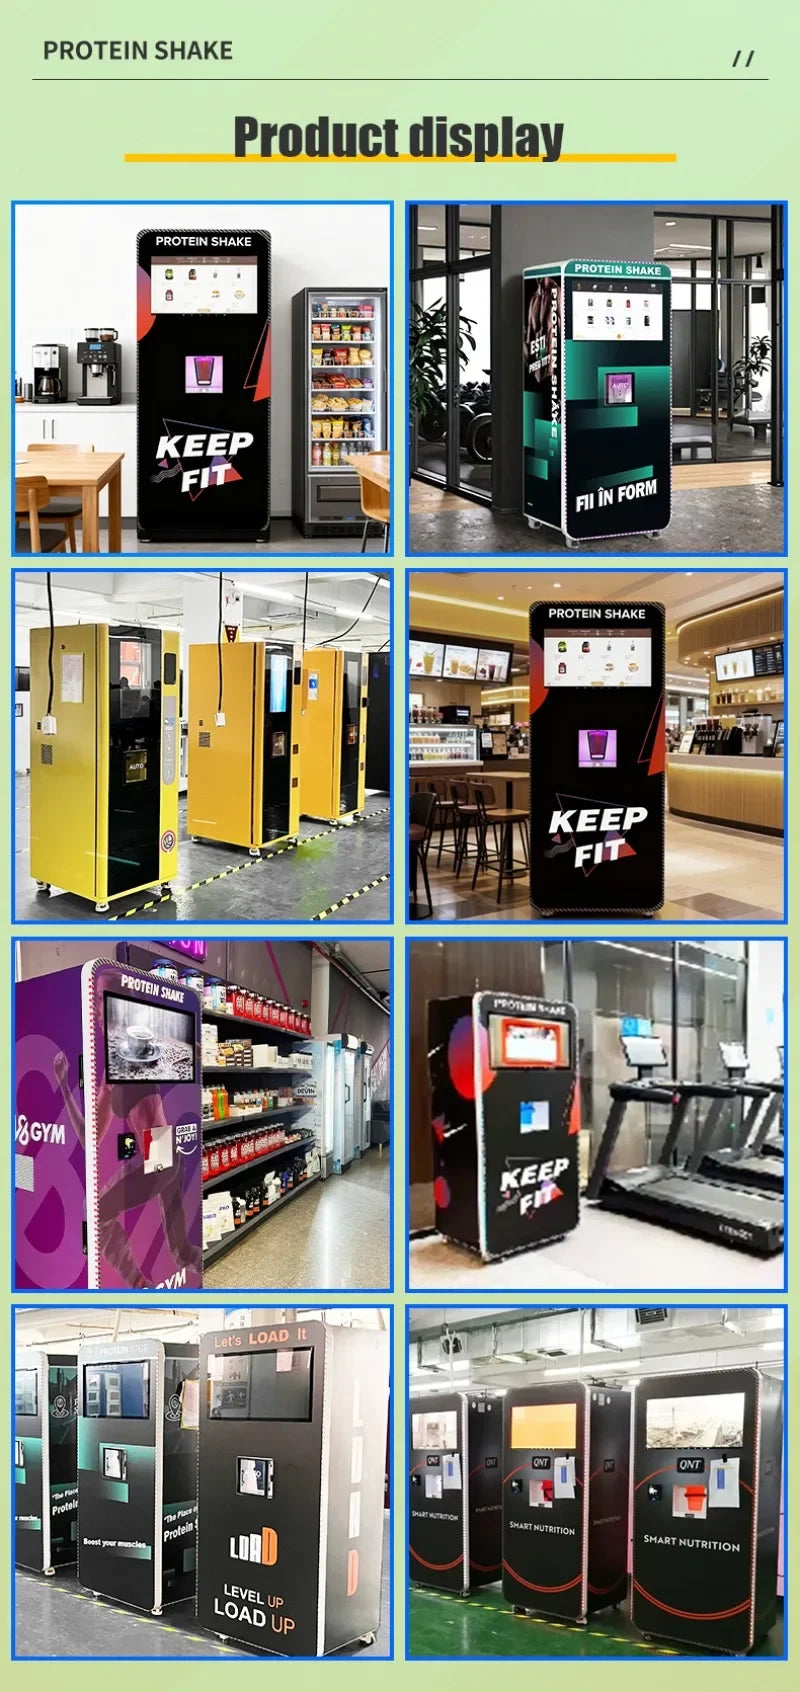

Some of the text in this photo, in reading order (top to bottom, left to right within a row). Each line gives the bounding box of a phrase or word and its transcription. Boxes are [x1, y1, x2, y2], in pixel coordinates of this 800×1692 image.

[156, 236, 252, 247] PROTEIN SHAKE
[575, 263, 661, 276] PROTEIN SHAKE
[551, 375, 559, 438] SHAKE
[155, 432, 254, 459] KEEP
[181, 463, 232, 493] FIT
[575, 492, 594, 513] FII
[618, 479, 657, 502] FORM
[548, 608, 646, 619] PROTEIN SHAKE
[548, 806, 648, 834] KEEP
[574, 838, 626, 868] FIT
[121, 973, 184, 1003] PROTEIN SHAKE
[500, 1157, 569, 1192] KEEP
[214, 1328, 307, 1348] Let's LOAD It
[428, 1456, 439, 1464] QNT
[533, 1458, 548, 1467] QNT
[680, 1460, 702, 1470] QNT
[412, 1510, 458, 1521] SMART NUTRITION
[164, 1521, 193, 1542] Protein
[509, 1521, 575, 1536] SMART NUTRITION
[102, 1540, 116, 1548] your
[229, 1526, 278, 1566] LOAD
[643, 1534, 740, 1552] SMART NUTRITION
[224, 1583, 284, 1608] LEVEL UP
[214, 1598, 295, 1635] LOAD UP
